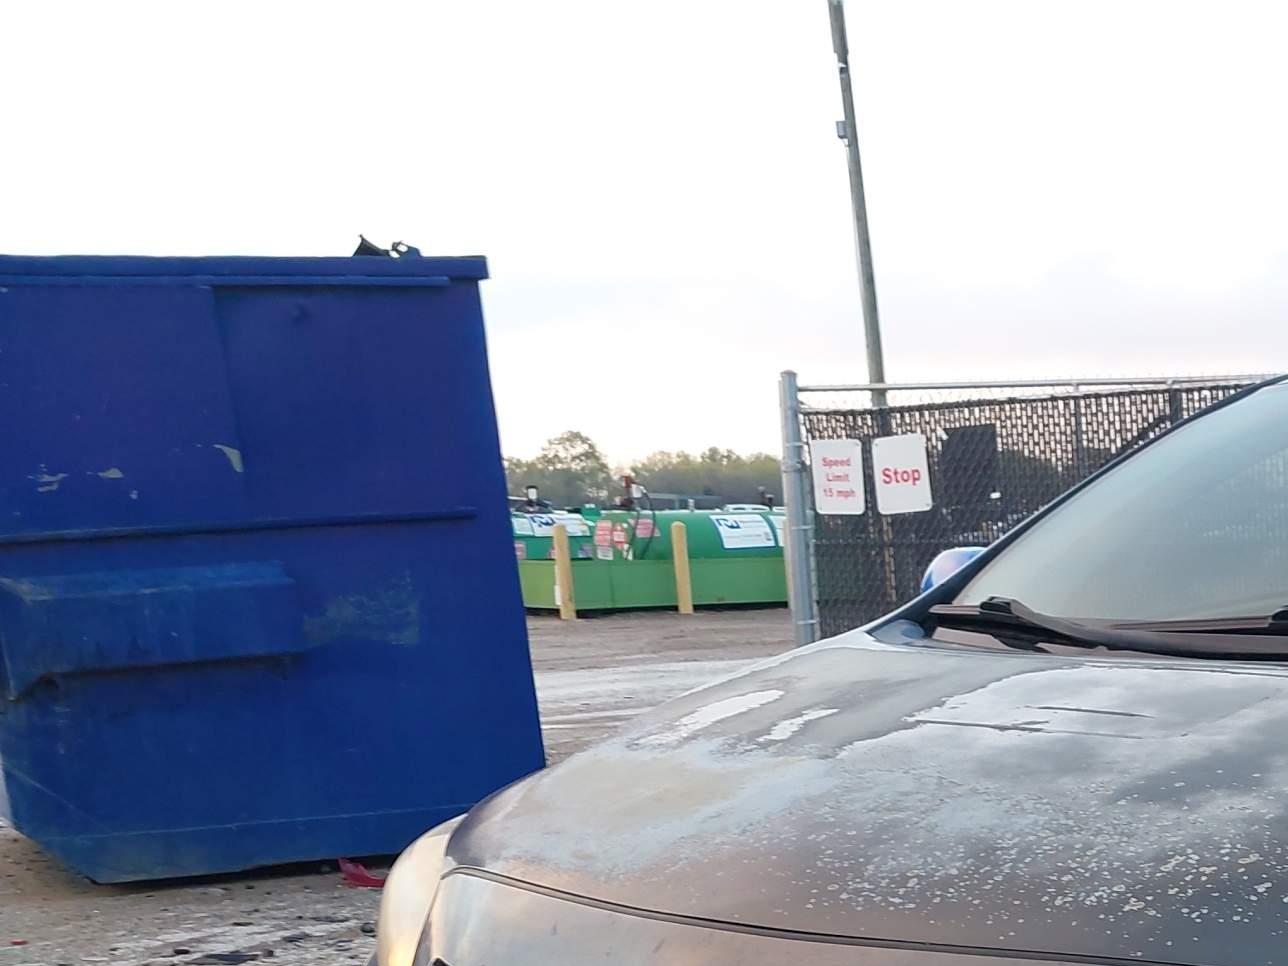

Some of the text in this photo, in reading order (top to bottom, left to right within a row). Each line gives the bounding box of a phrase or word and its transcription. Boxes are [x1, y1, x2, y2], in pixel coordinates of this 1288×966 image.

[822, 457, 851, 469] Speed
[826, 474, 850, 482] Limit
[882, 468, 921, 485] Stop
[823, 488, 856, 498] 15 mph
